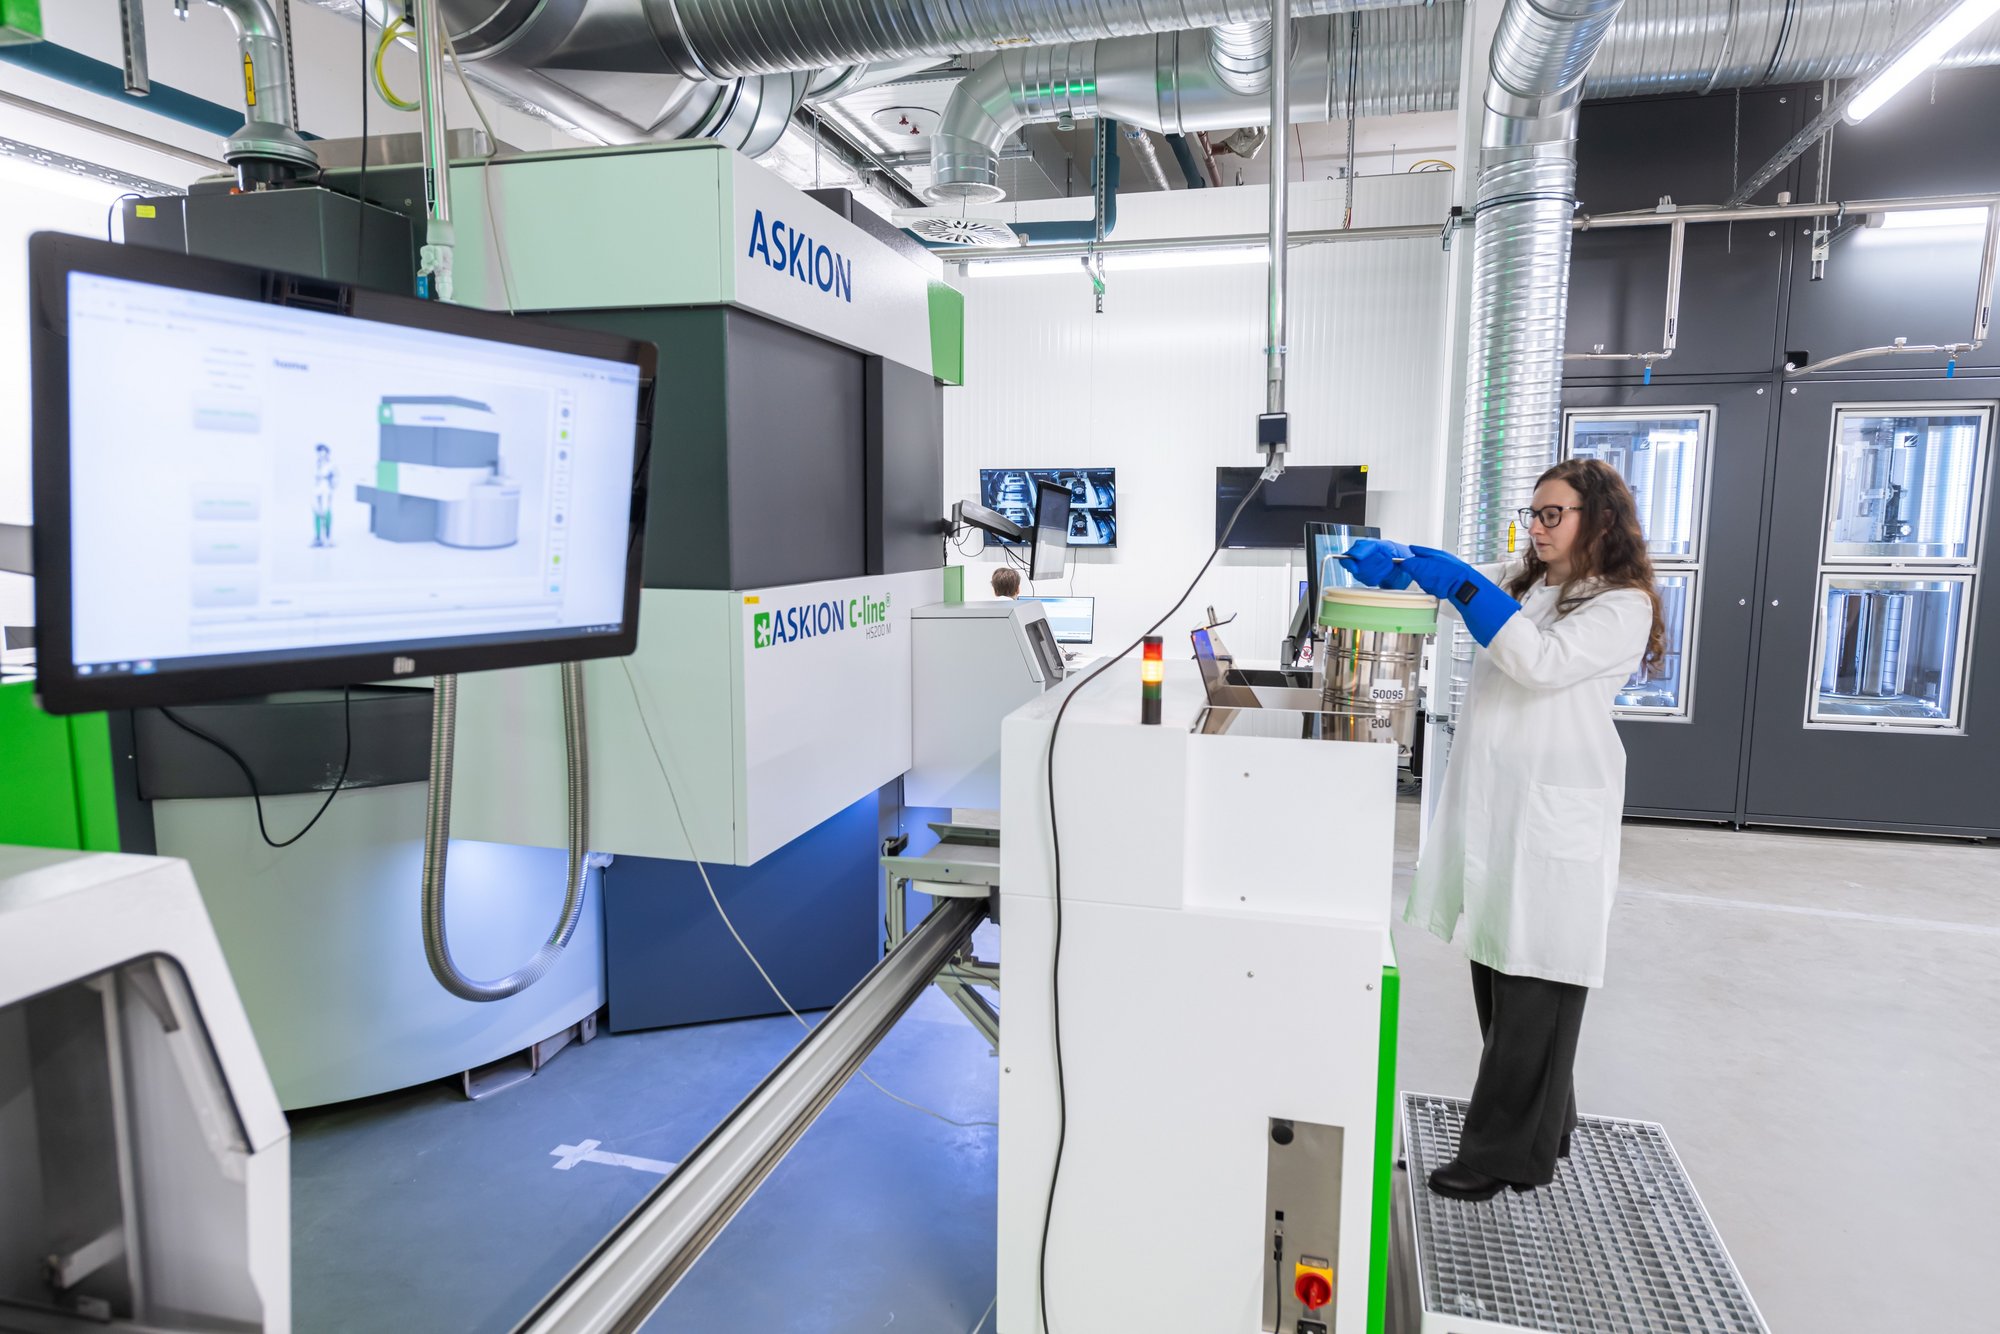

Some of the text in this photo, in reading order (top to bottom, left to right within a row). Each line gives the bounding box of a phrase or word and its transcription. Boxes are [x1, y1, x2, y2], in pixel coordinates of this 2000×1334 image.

[748, 209, 852, 303] ASKION
[772, 600, 844, 645] ASKION
[1372, 689, 1404, 700] 50095
[1371, 718, 1391, 729] 200
